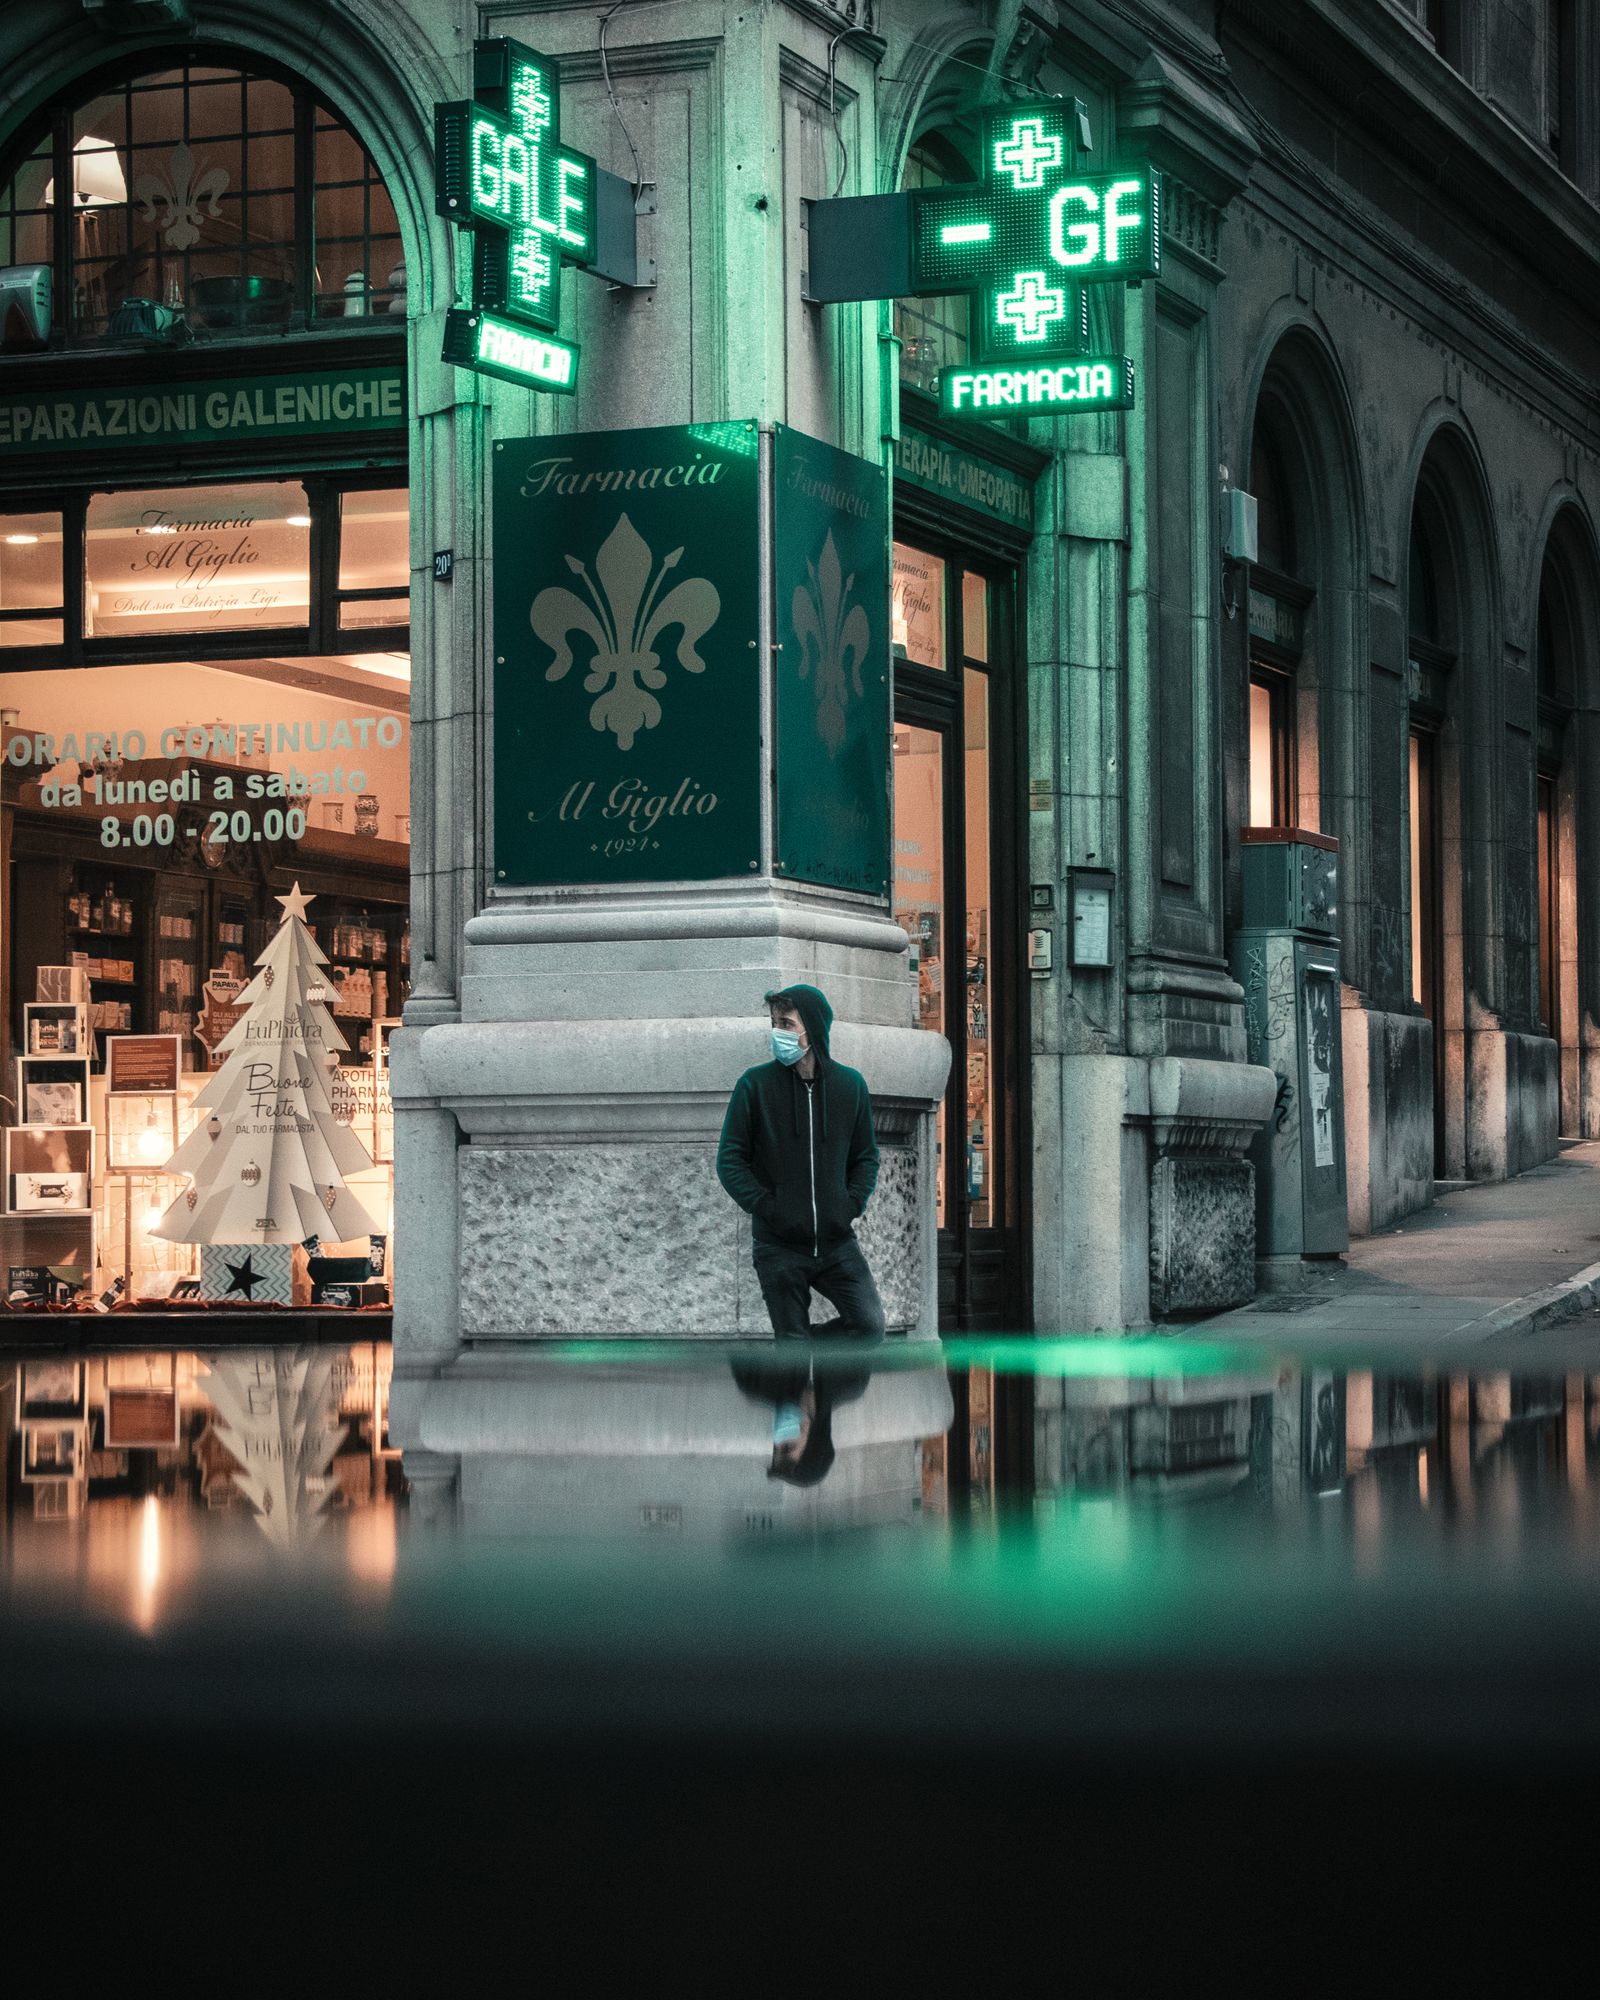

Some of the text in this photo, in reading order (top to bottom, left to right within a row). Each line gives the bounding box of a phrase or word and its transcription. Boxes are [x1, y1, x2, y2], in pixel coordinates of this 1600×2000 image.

[472, 119, 586, 247] GALE
[1051, 181, 1141, 266] GF
[205, 378, 403, 430] GALENICHE
[952, 364, 1113, 408] FARMACIA
[520, 452, 729, 498] Farmacia
[786, 455, 871, 520] Farmacia
[135, 509, 256, 536] Farmacia
[130, 536, 262, 590] Al Giglio
[7, 716, 403, 767] ORARIO CONTINUATO
[40, 764, 367, 808] da lunedì a sabato
[527, 776, 719, 834] Al Giglio
[101, 813, 175, 849] 8.00
[208, 808, 306, 845] 20.00
[212, 981, 240, 989] PAPAYA
[246, 1019, 323, 1039] EuPhidra
[243, 1062, 314, 1092] Buone
[249, 1091, 299, 1118] Feste
[235, 1123, 316, 1134] DAL TUO FARMACISTA
